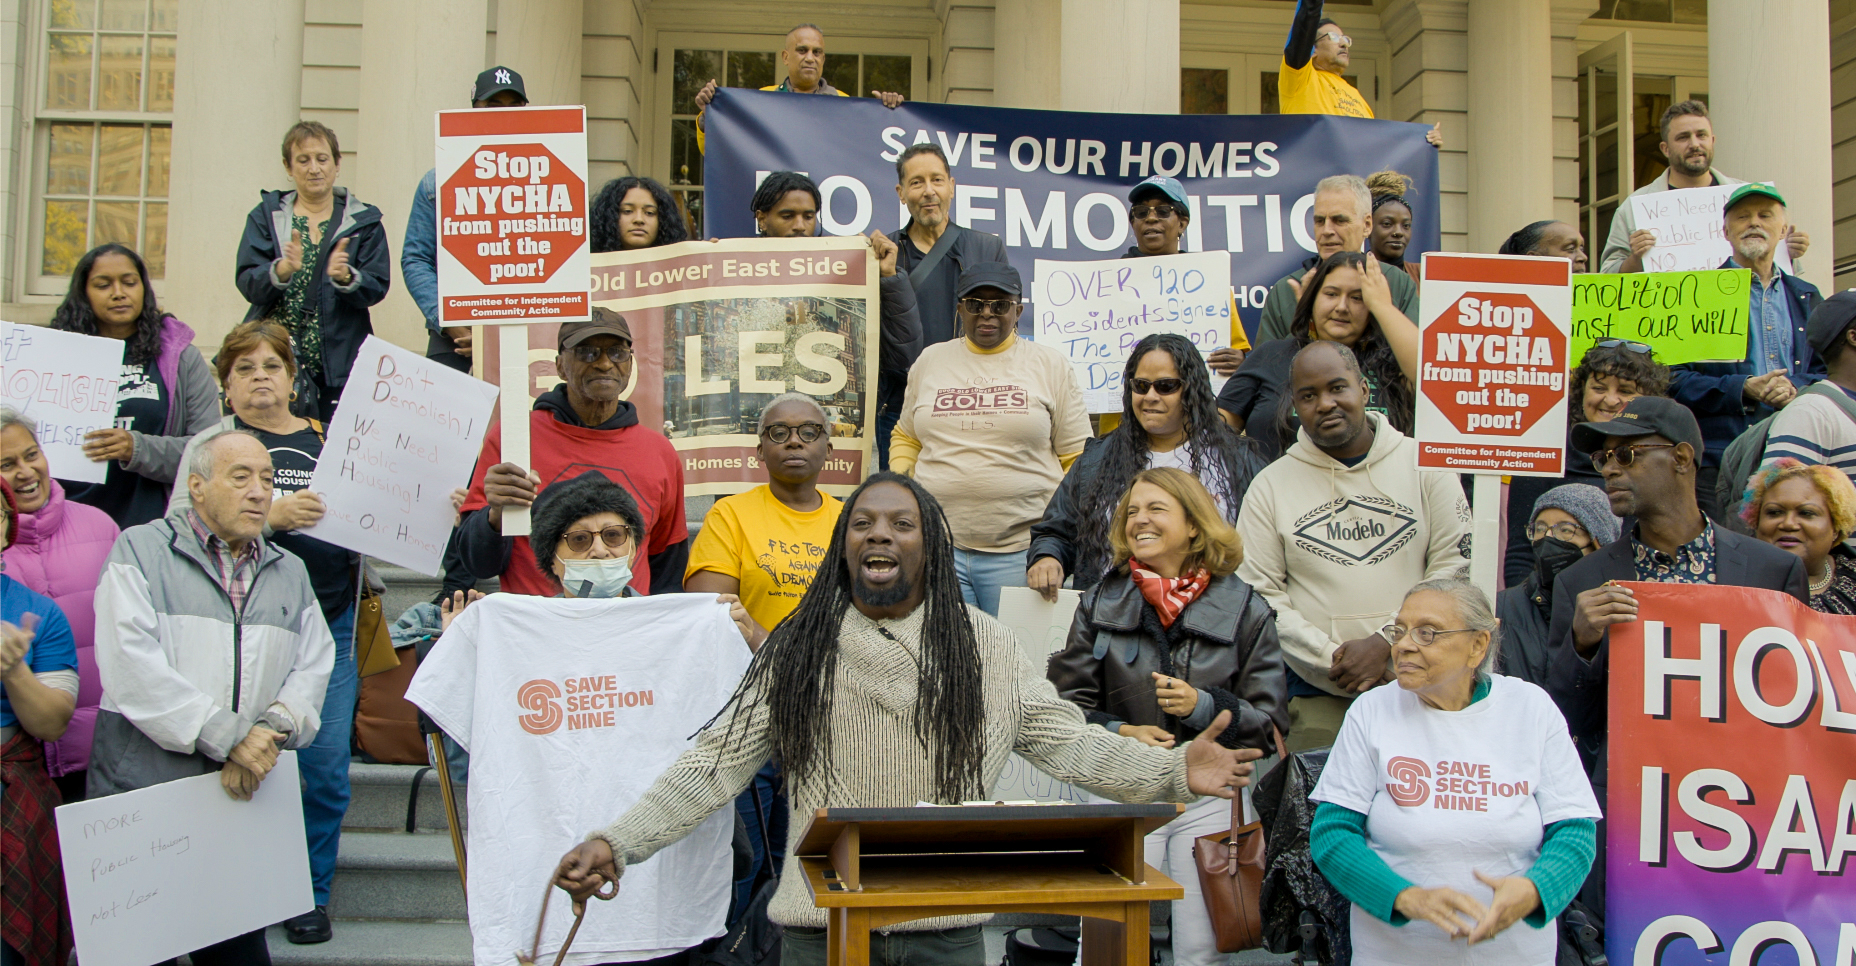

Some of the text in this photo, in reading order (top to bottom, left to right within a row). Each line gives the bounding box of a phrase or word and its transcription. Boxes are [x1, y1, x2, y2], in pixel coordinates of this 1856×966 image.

[475, 150, 550, 184] Stop
[1009, 136, 1105, 175] OUR
[1119, 141, 1280, 178] HOMES
[455, 184, 573, 215] NYCHA
[756, 170, 872, 236] O
[1642, 200, 1670, 220] We
[1677, 196, 1717, 216] Need
[443, 214, 584, 238] from pushing
[477, 237, 551, 256] out the
[490, 258, 545, 282] poor!
[636, 263, 713, 288] Lower
[722, 259, 780, 278] East
[789, 257, 848, 276] Side
[1047, 267, 1141, 306] OVER
[1152, 265, 1205, 295] 920
[449, 295, 582, 307] Committee for Independent
[471, 306, 560, 316] Community Action
[1043, 298, 1230, 335] Residents Signed
[1458, 297, 1533, 335] Stop
[1062, 336, 1111, 358] The
[1436, 332, 1553, 366] NYCHA
[377, 355, 434, 391] Don't
[685, 331, 848, 396] LES
[1423, 362, 1563, 391] from pushing
[0, 366, 118, 413] OLISH
[936, 391, 1026, 409] GOLES
[1456, 388, 1529, 407] out the
[372, 381, 473, 440] Demolish!
[1467, 411, 1522, 431] poor!
[354, 414, 439, 464] We Need
[686, 457, 742, 471] Homes
[747, 456, 760, 469] &
[1424, 446, 1556, 459] Committee for Independent
[1445, 457, 1534, 468] Community Action
[1327, 518, 1385, 541] Modelo
[782, 572, 815, 590] DEMO
[565, 675, 618, 694] SAVE
[1644, 620, 1856, 729] HOL
[566, 690, 654, 712] SECTION
[567, 711, 616, 731] NINE
[1436, 761, 1491, 779] SAVE
[1435, 777, 1529, 798] SECTION
[1434, 795, 1488, 812] NINE
[83, 810, 143, 839] MORE
